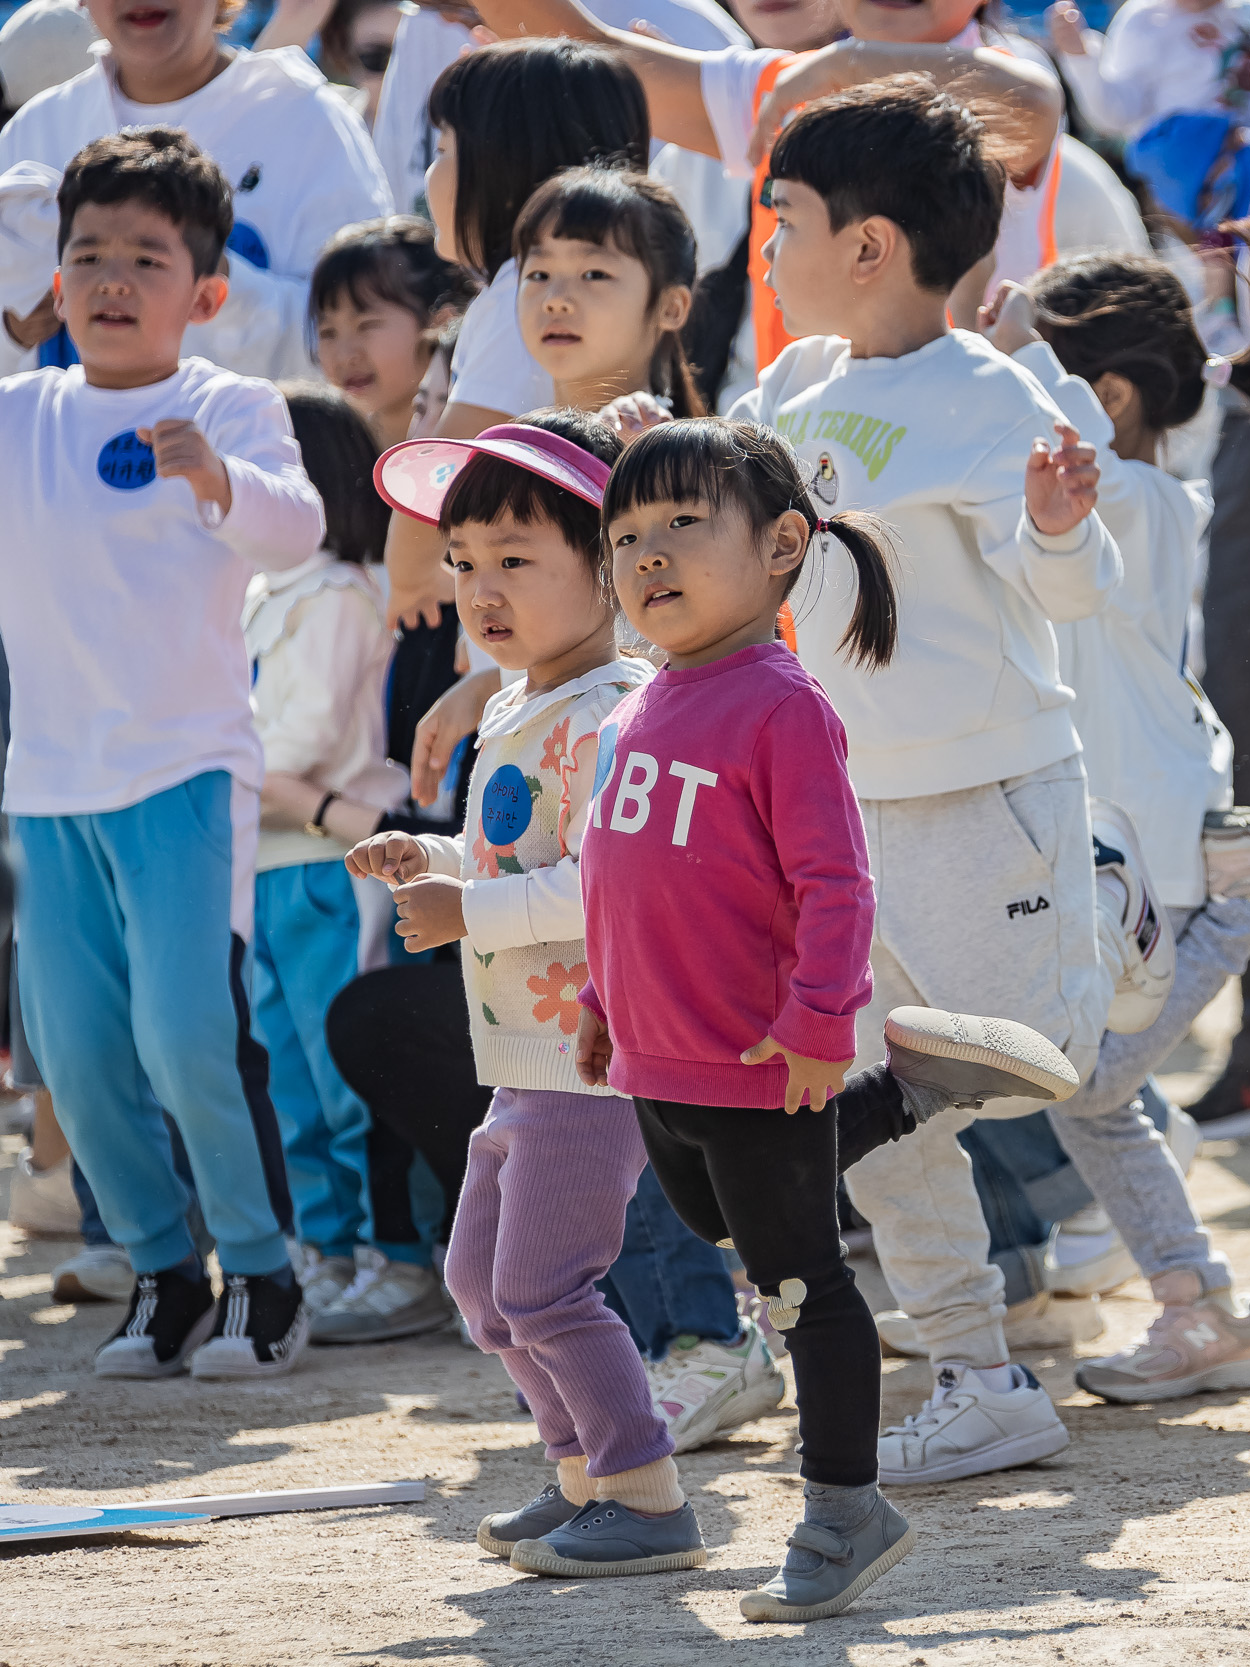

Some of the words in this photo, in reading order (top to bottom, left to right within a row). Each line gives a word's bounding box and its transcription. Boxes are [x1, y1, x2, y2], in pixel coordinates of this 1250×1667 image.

[812, 410, 907, 482] TENNIS
[491, 781, 519, 803] 아이짐
[487, 807, 517, 829] 주지안
[1006, 895, 1050, 919] FILA
